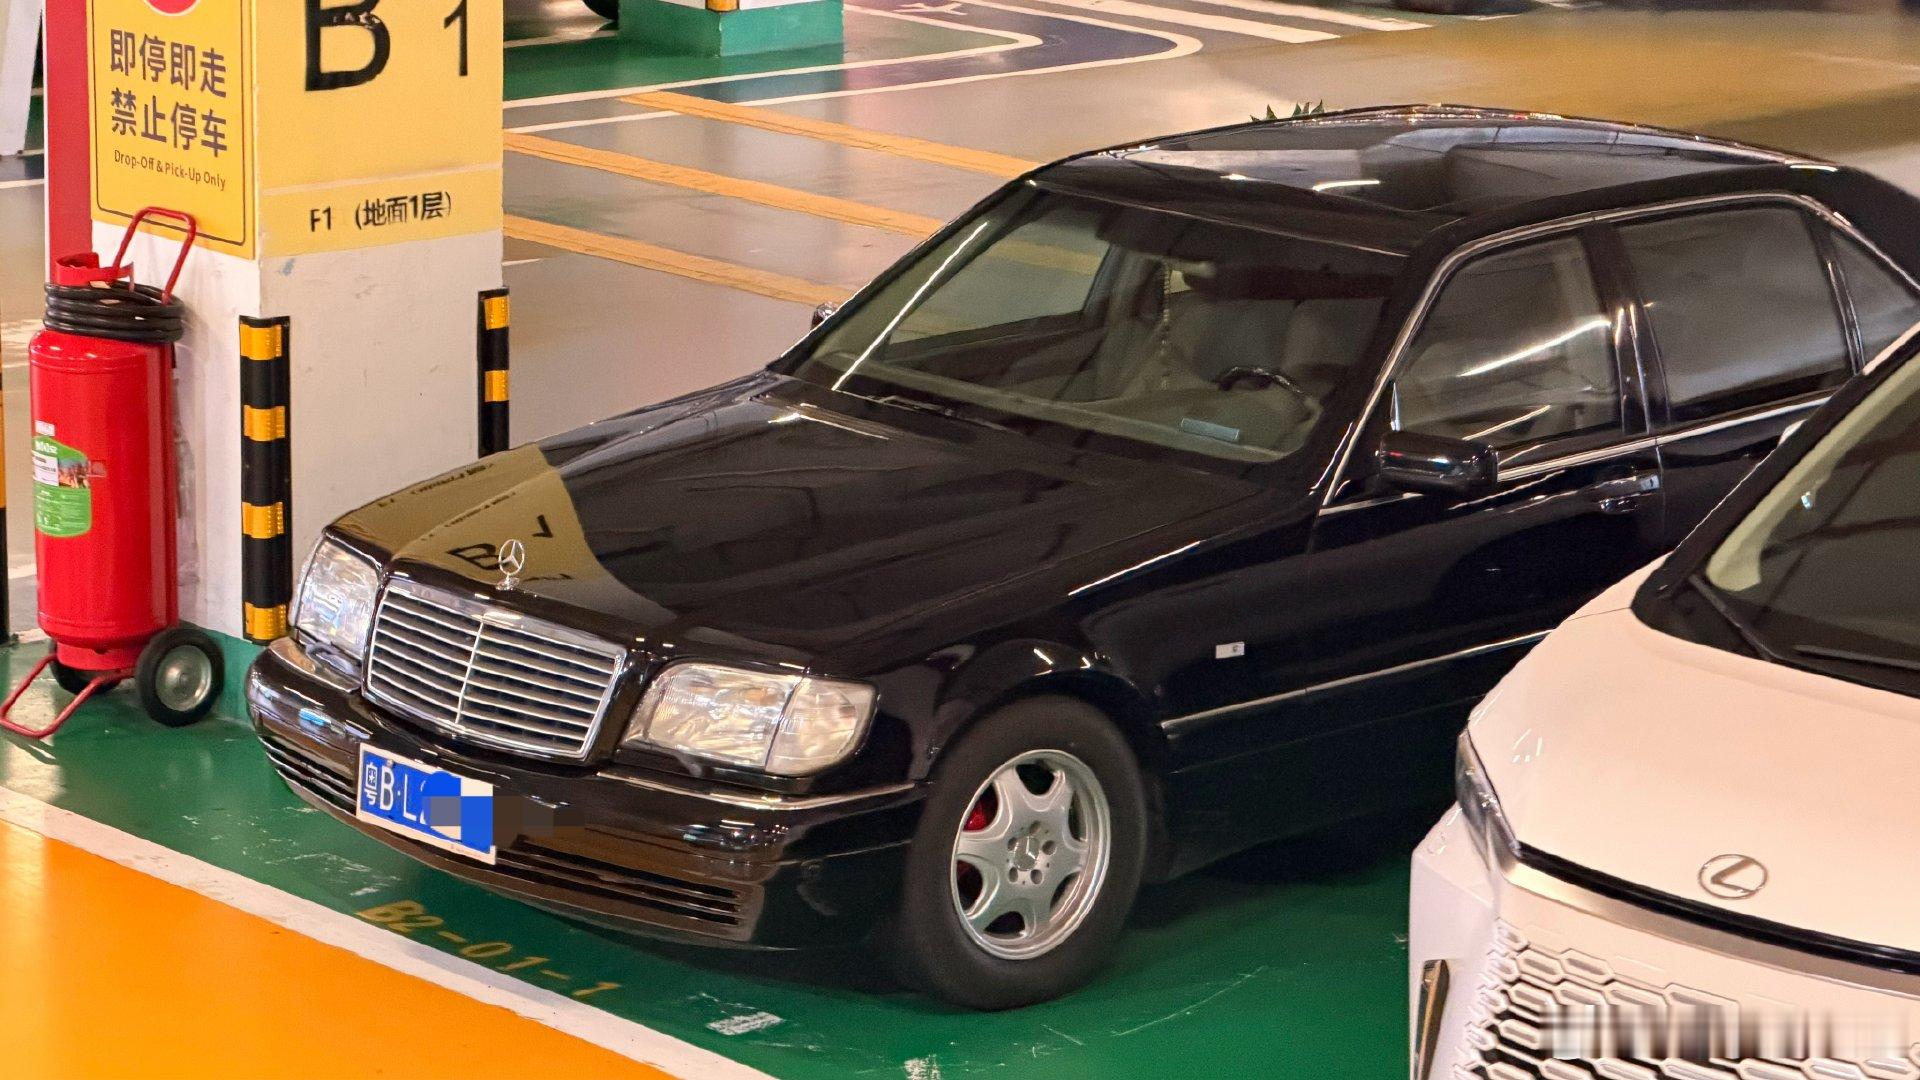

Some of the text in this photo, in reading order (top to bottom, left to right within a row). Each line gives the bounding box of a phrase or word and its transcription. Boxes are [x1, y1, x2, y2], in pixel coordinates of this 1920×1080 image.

[110, 29, 227, 98] 即停即走
[305, 0, 390, 91] B
[111, 87, 227, 157] 禁止停车
[114, 149, 154, 170] Drop-Off
[165, 162, 201, 184] Pick-Up
[203, 171, 226, 191] Only
[310, 206, 332, 232] F1
[354, 900, 622, 996] B2-01-1
